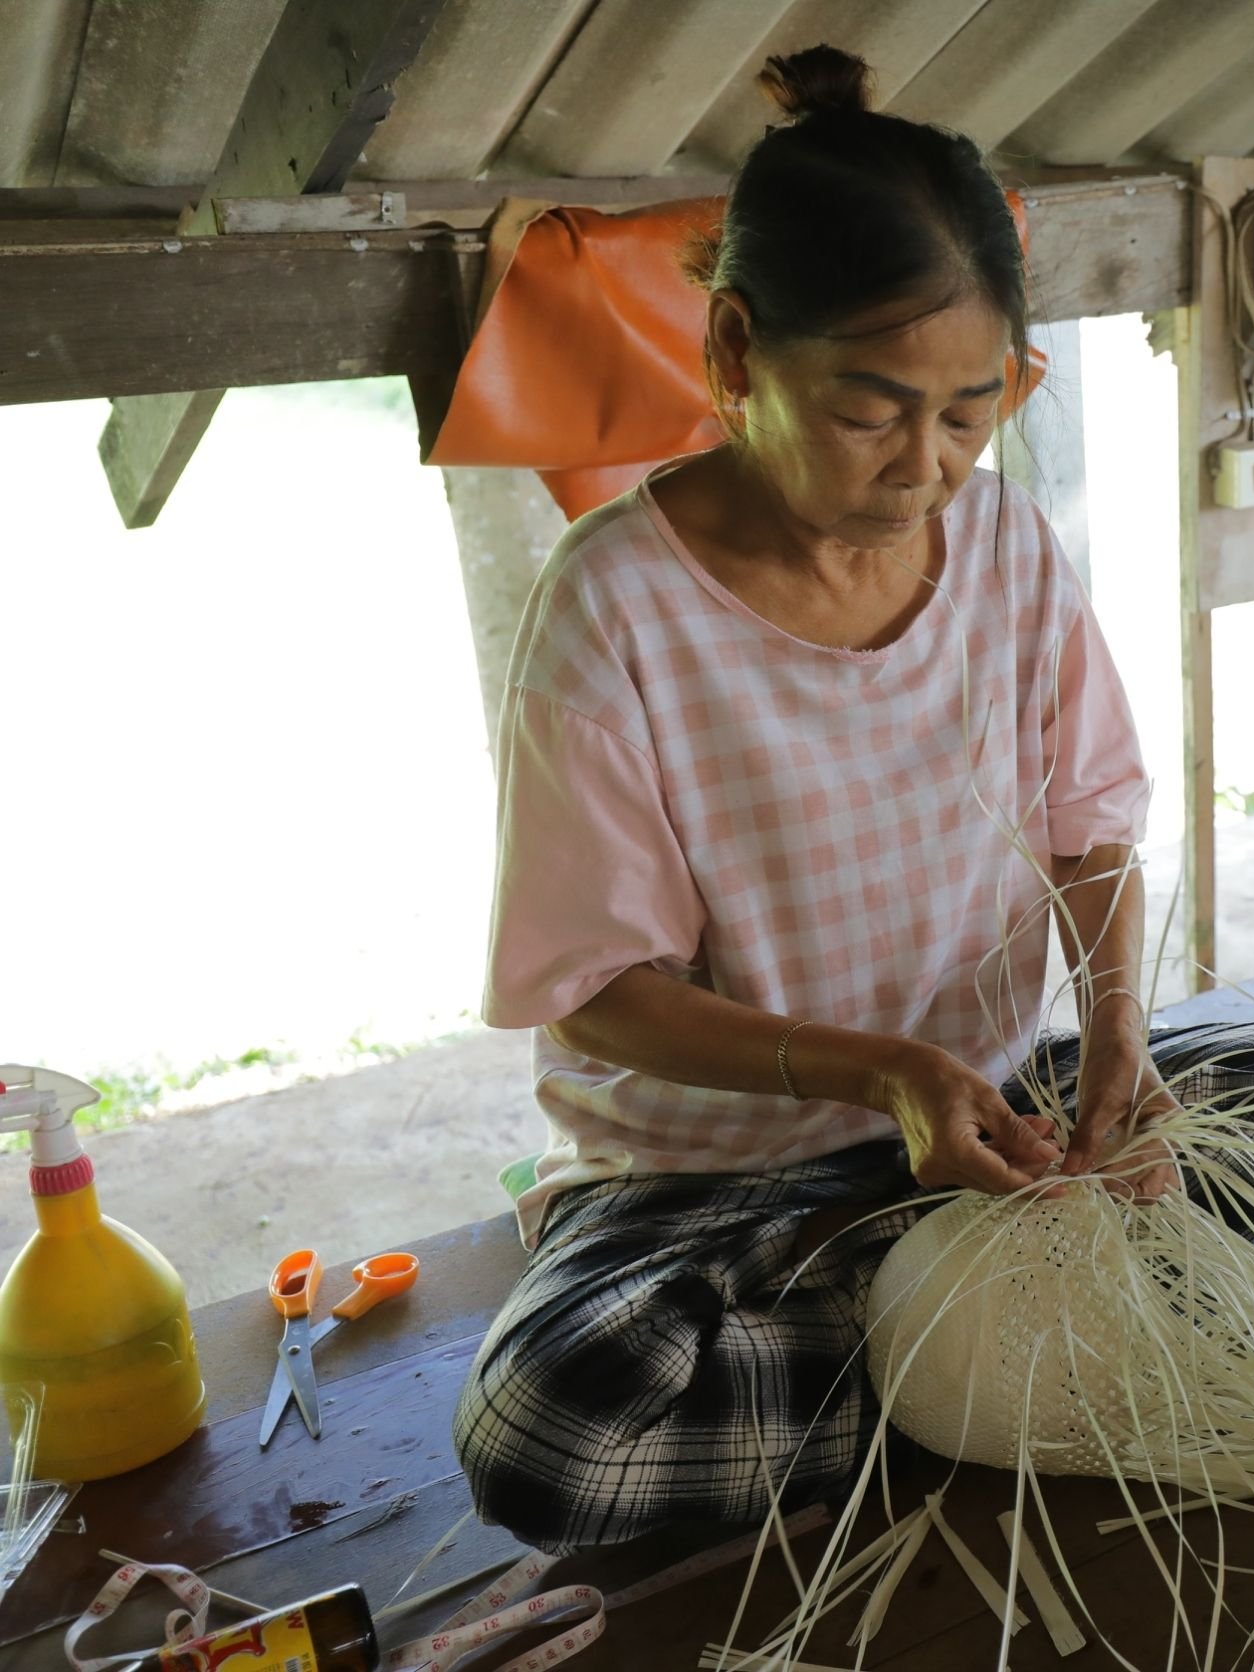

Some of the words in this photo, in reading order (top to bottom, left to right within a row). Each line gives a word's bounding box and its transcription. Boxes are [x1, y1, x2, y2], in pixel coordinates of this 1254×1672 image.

[575, 1587, 591, 1599] 29
[528, 1597, 545, 1612] 30
[483, 1617, 500, 1632] 31
[431, 1635, 450, 1651] 32
